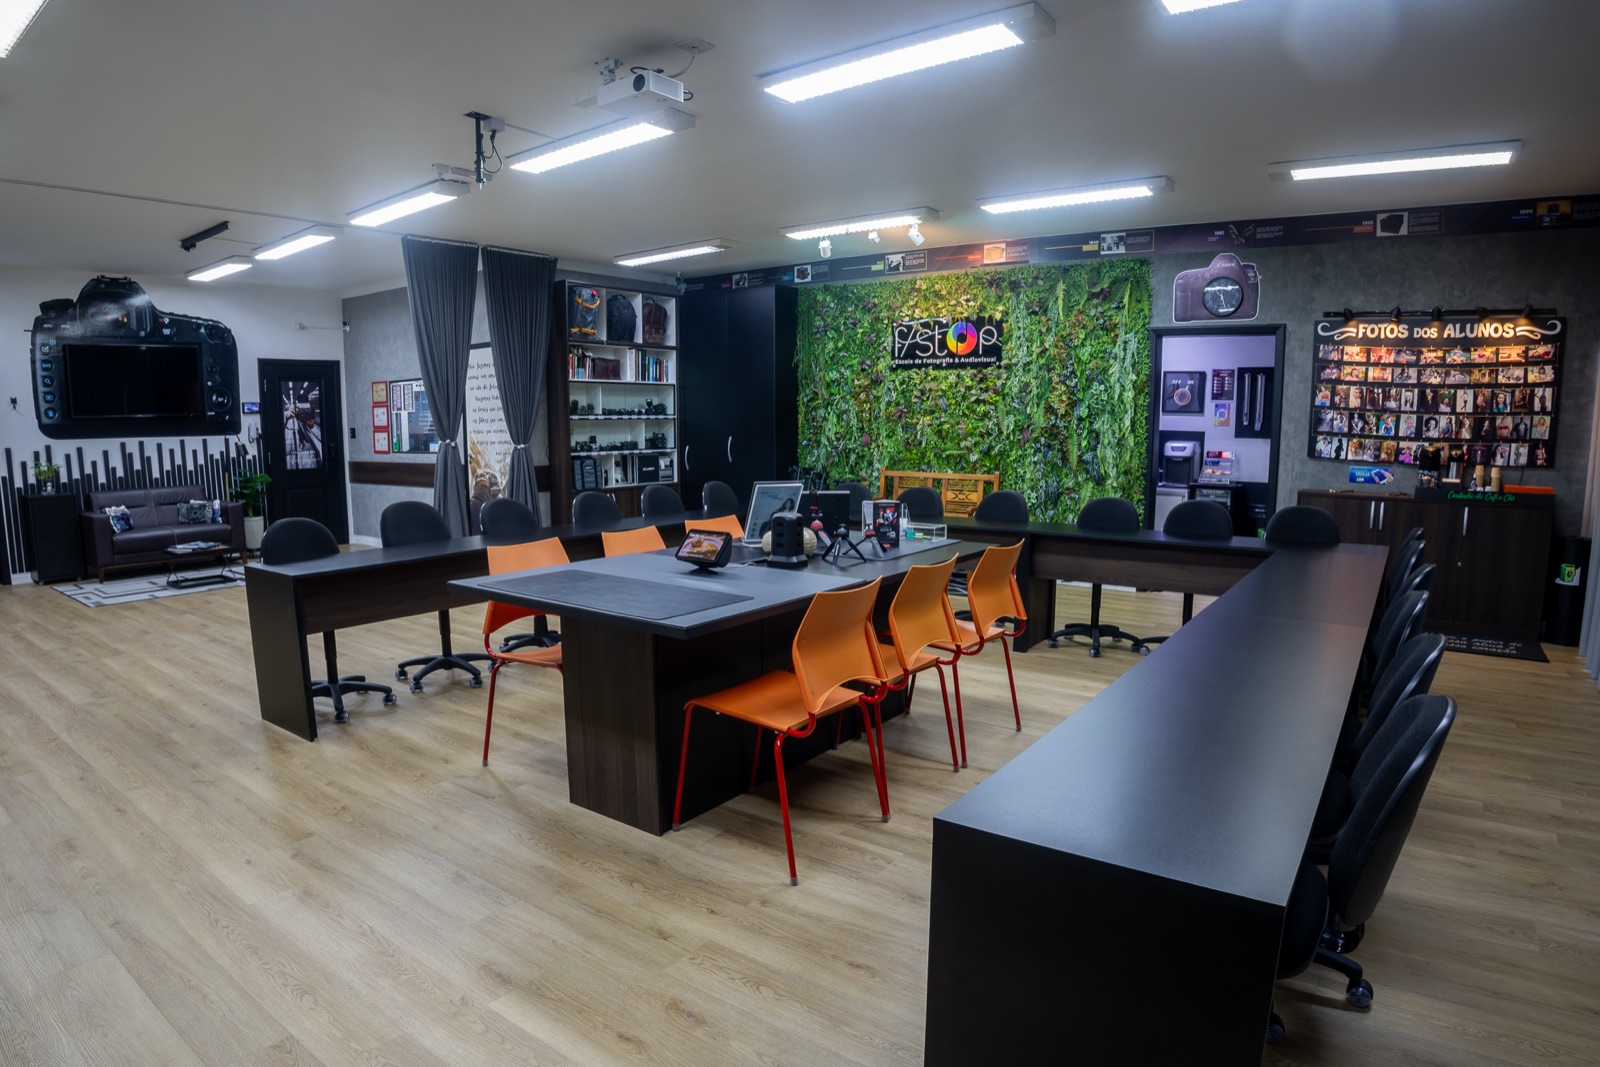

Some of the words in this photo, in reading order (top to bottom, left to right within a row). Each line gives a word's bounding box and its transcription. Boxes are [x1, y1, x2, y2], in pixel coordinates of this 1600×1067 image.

[1357, 323, 1409, 339] FOTOS
[1414, 327, 1438, 338] DOS
[1444, 322, 1515, 338] ALUNOS
